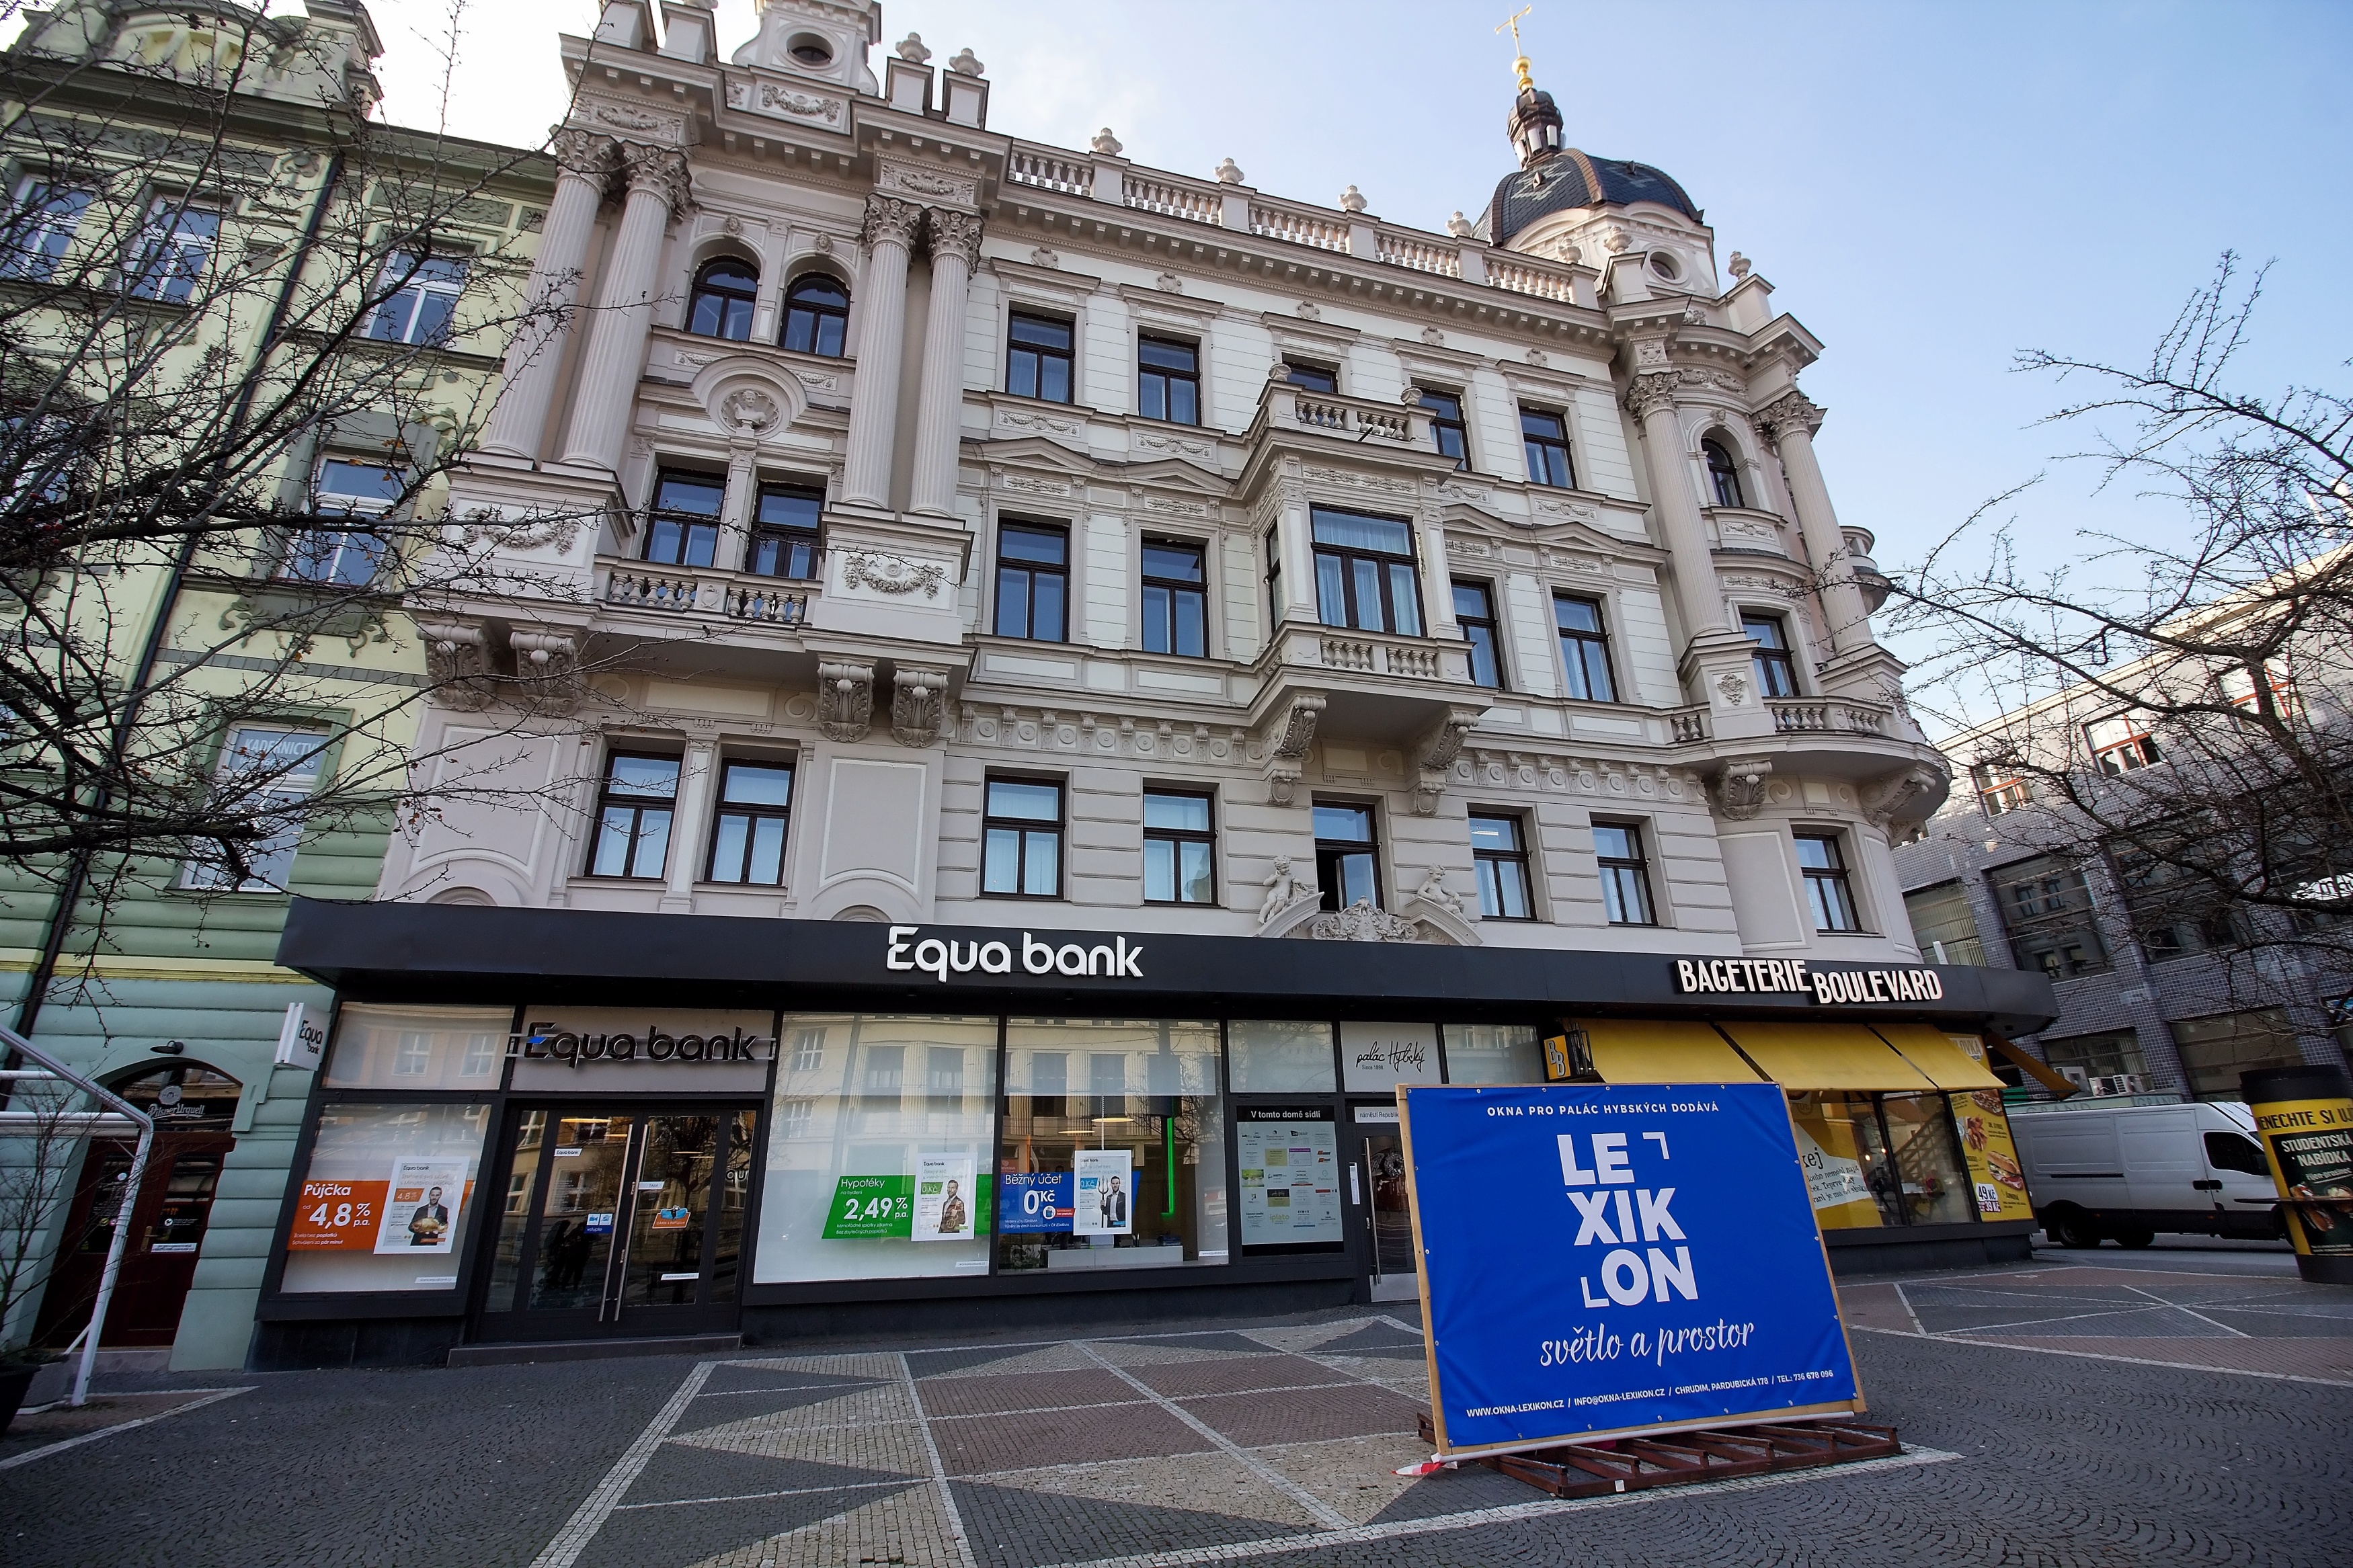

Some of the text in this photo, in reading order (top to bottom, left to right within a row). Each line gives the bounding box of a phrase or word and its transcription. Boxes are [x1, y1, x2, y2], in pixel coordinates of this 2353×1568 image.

[887, 926, 1144, 983] Equa bank
[1677, 960, 1943, 1003] BAGETERIE BOULEVARD
[299, 1020, 323, 1046] Equa
[307, 1045, 320, 1055] bank
[524, 1022, 758, 1069] Equa bank
[1356, 1040, 1425, 1073] palác Hybský
[147, 1103, 205, 1118] Pilsner Urquell
[1283, 1110, 1303, 1118] domě
[1487, 1100, 1719, 1116] OKNA PRO PALÁC HYBSKÝCH DODÁVÁ
[2320, 1110, 2336, 1124] SI
[2281, 1131, 2353, 1153] STUDENTSKÁ
[1557, 1132, 1635, 1186] LE
[2297, 1150, 2352, 1167] NABÍDKA
[841, 1178, 885, 1188] Hypotéky
[1005, 1173, 1062, 1187] Běžný účet
[1822, 1180, 1842, 1190] Teprve
[304, 1184, 352, 1198] Půjčka
[397, 1192, 410, 1200] 4,8
[1979, 1186, 1996, 1200] 49 Kč
[844, 1197, 893, 1221] 2,49
[895, 1197, 908, 1210] %
[1024, 1190, 1055, 1214] 0 Kč
[1985, 1201, 1993, 1212] 39
[309, 1203, 351, 1229] 4,8
[356, 1202, 371, 1216] %
[353, 1219, 371, 1227] p.a.
[1566, 1188, 1687, 1246] XIK
[1540, 1318, 1754, 1367] světlo a prostor
[1466, 1399, 1564, 1418] WWW.OKNA-LEXIKON.CZ
[1574, 1389, 1665, 1406] INFO@OKNA-LEXIKON.CZ
[1675, 1383, 1710, 1395] CHRUDIM,
[1711, 1376, 1756, 1391] PARDUBICKÁ
[1757, 1377, 1769, 1386] 178
[1777, 1375, 1793, 1383] TEL.:
[1793, 1373, 1805, 1381] 736
[1806, 1372, 1819, 1380] 678
[1821, 1370, 1833, 1378] 096
